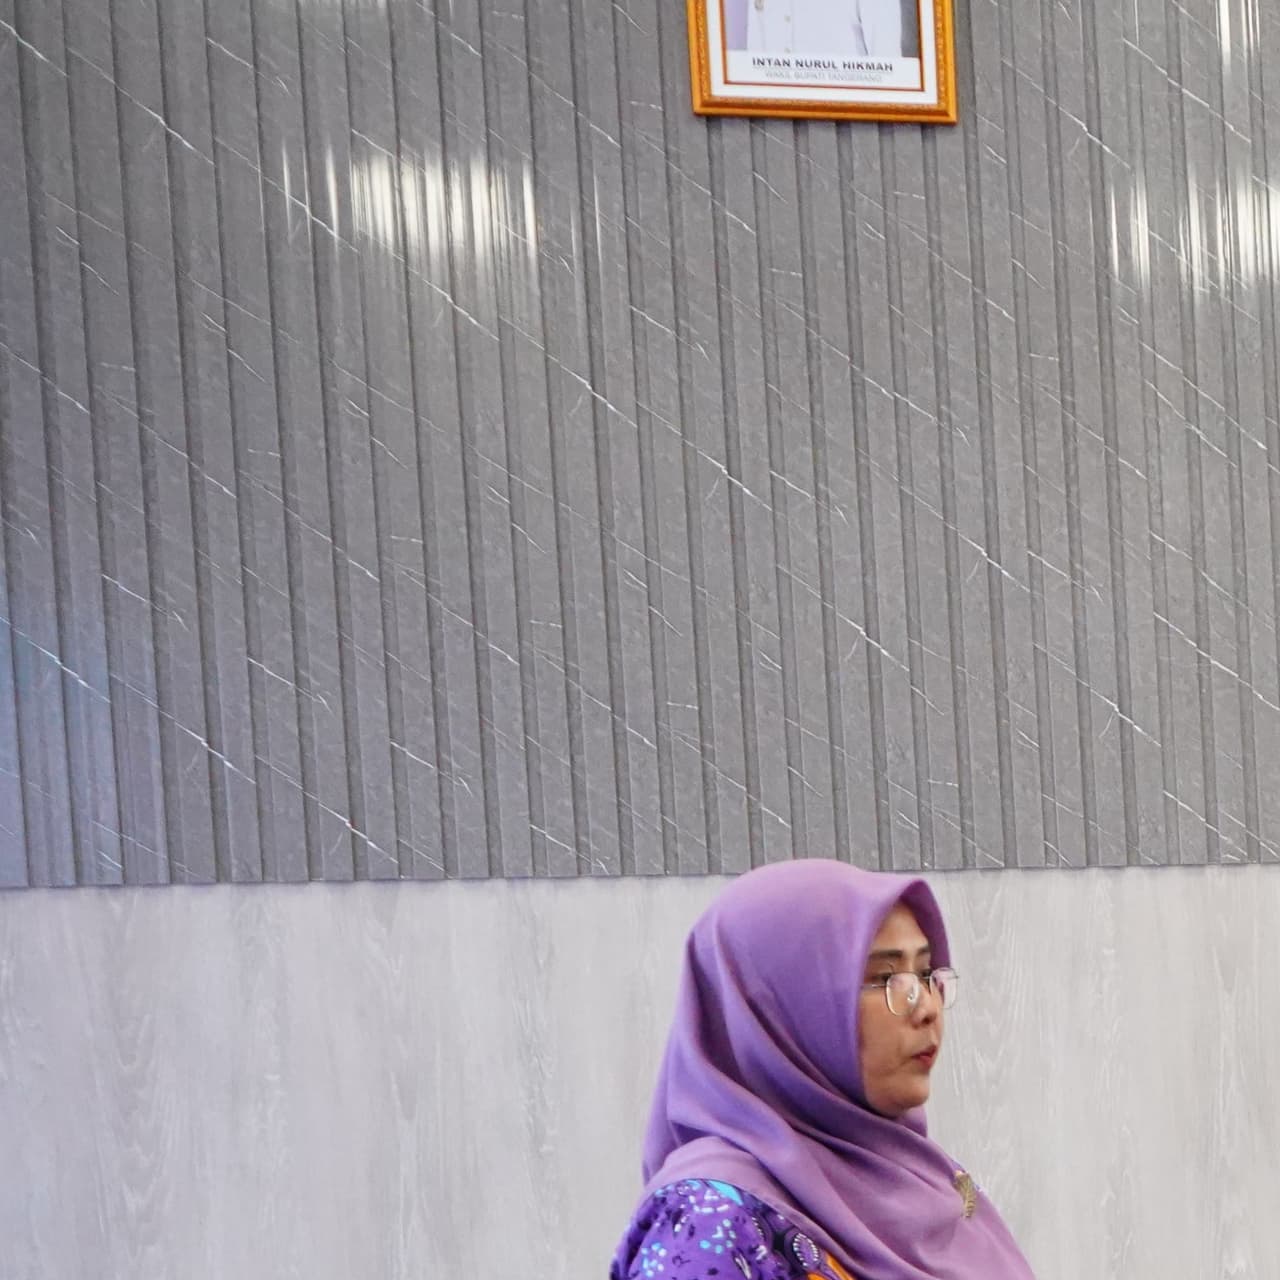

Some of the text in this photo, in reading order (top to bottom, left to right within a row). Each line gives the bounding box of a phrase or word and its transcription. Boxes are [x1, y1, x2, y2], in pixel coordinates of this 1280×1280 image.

[752, 57, 893, 73] INTAN NURUL HIKMAH
